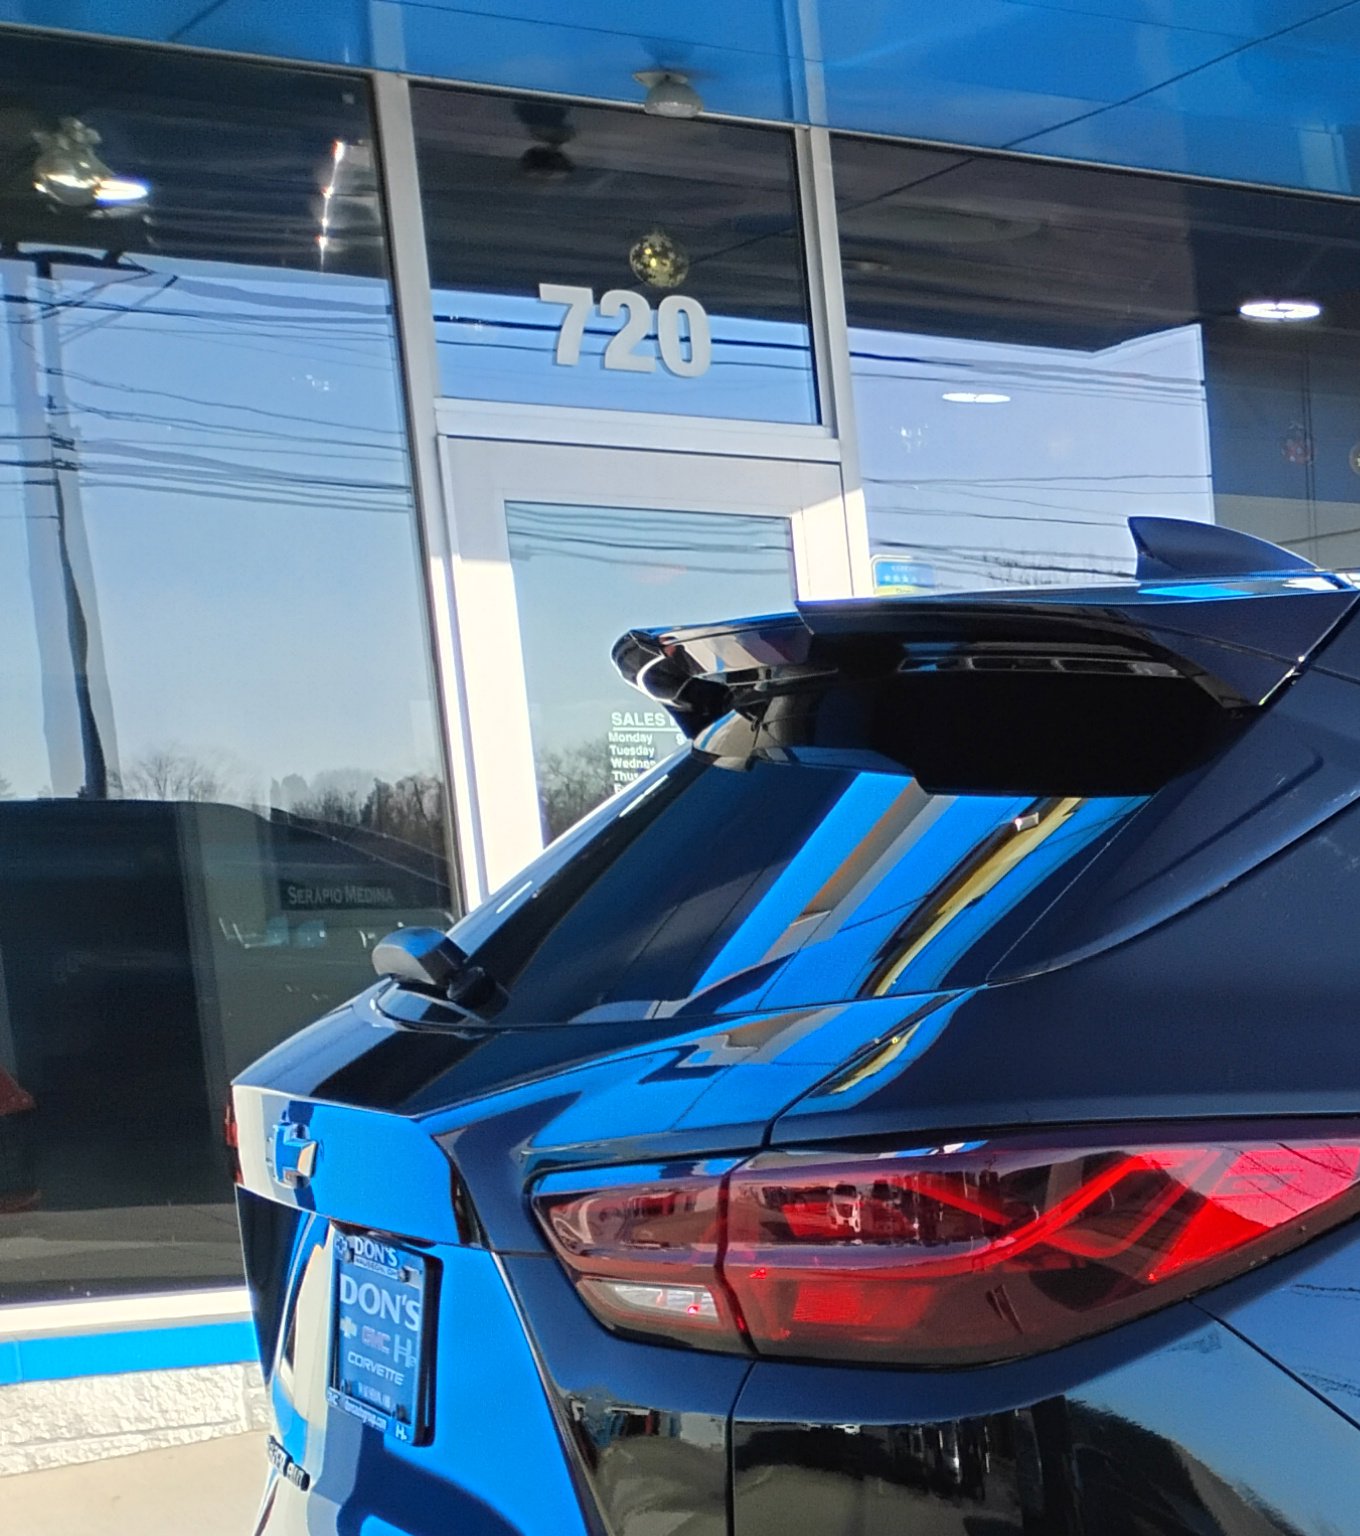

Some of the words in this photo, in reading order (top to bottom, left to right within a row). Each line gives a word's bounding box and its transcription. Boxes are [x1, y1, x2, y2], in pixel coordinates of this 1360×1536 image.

[538, 283, 712, 378] 720
[611, 711, 666, 727] SALES
[608, 731, 653, 745] Monday
[609, 744, 655, 758] Tuesday
[353, 1236, 398, 1268] DON'S
[340, 1273, 420, 1332] DON'S
[347, 1351, 405, 1386] CORVETTE
